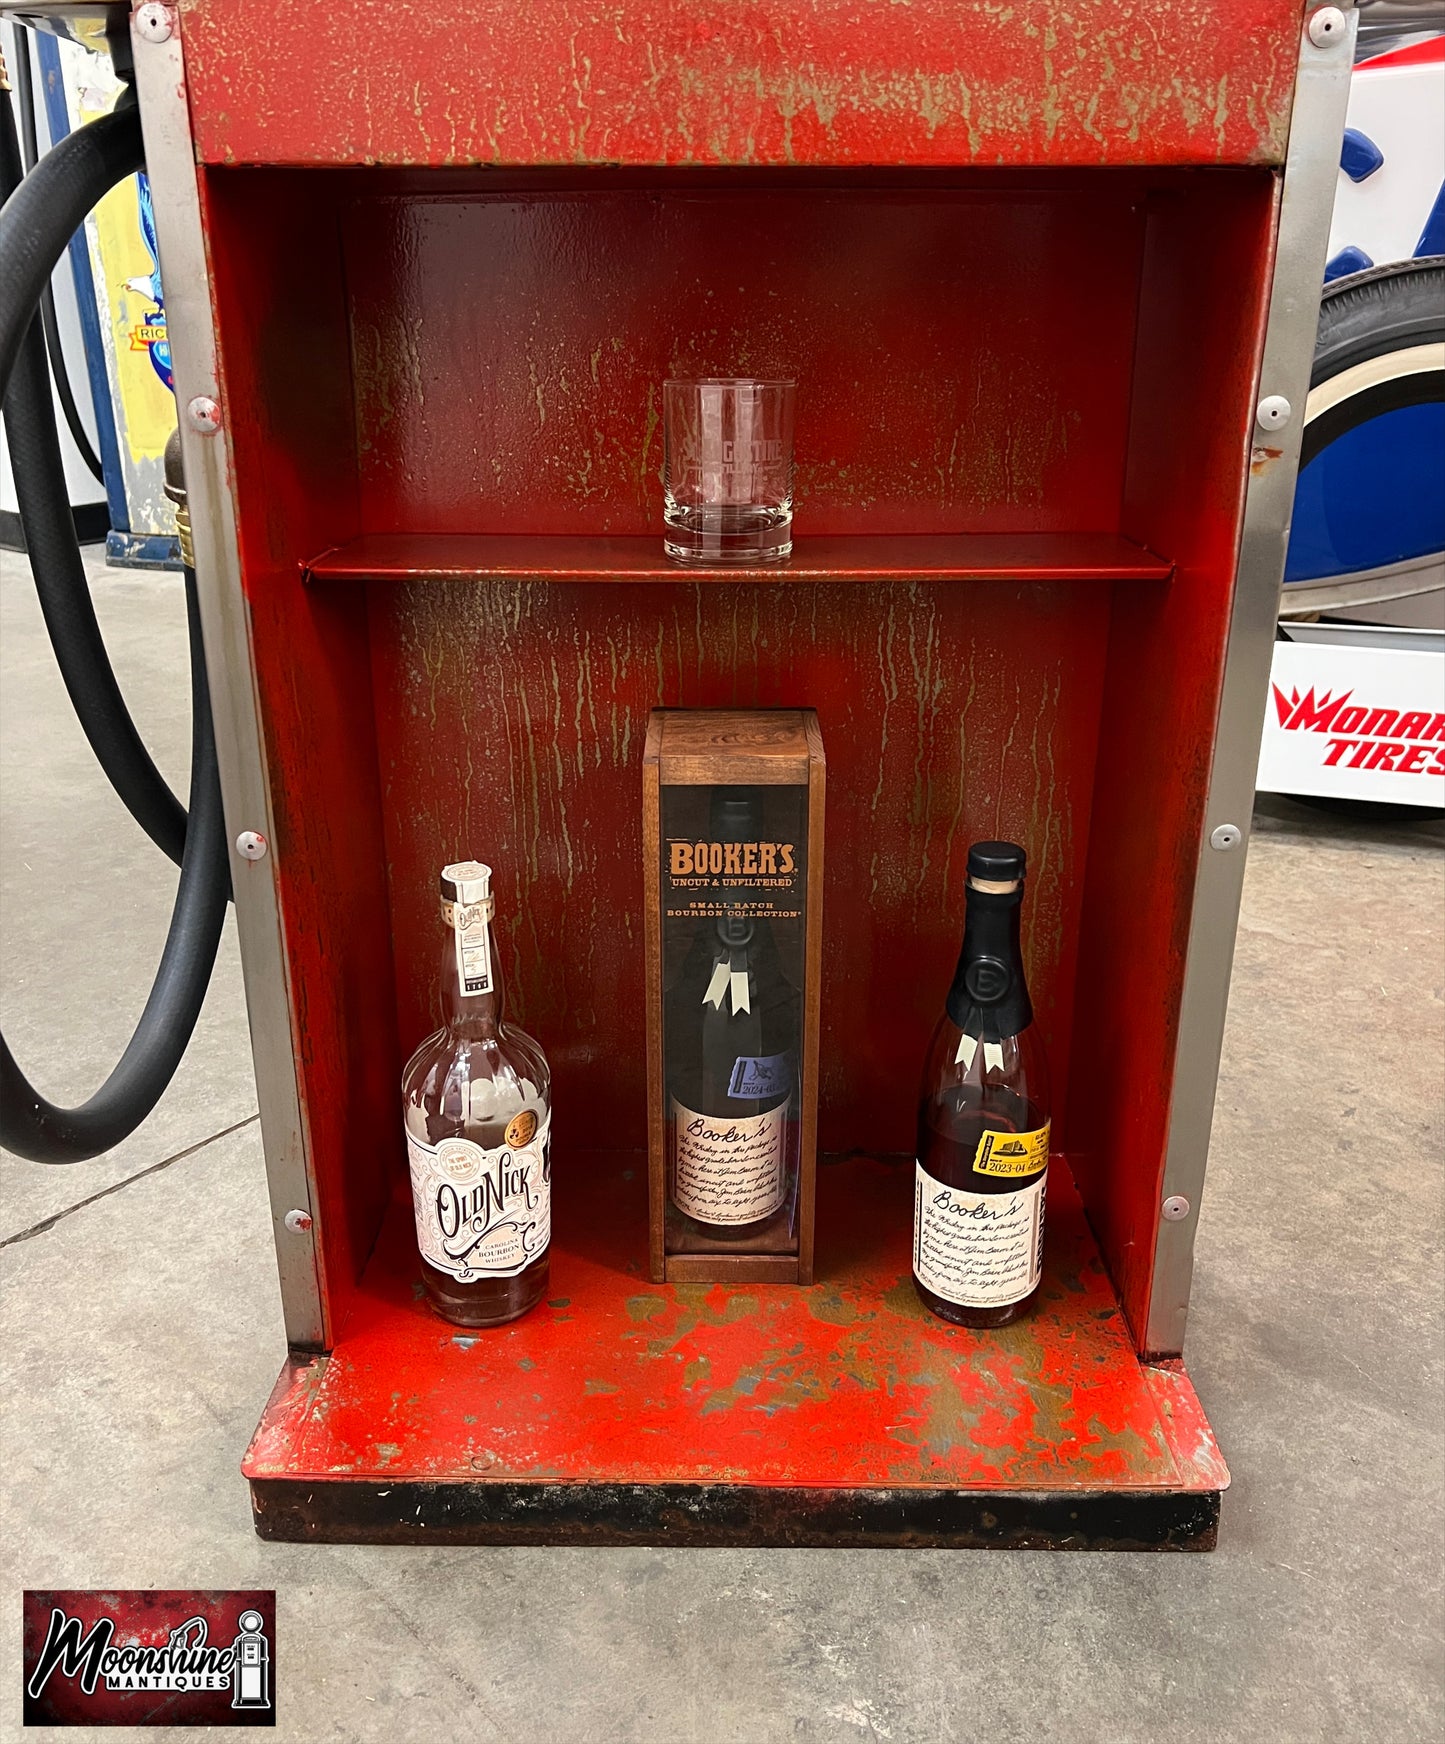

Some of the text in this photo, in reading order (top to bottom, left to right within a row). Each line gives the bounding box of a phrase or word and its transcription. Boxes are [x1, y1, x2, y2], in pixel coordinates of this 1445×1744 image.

[670, 842, 795, 875] BOOKER'S
[671, 878, 793, 887] UNCUT & UNFILTERED
[667, 909, 723, 917] BOURBON
[686, 1117, 772, 1143] Booker's
[932, 1190, 1024, 1220] Booker's
[478, 1244, 520, 1258] BOURBON
[485, 1239, 518, 1250] CAROLINA
